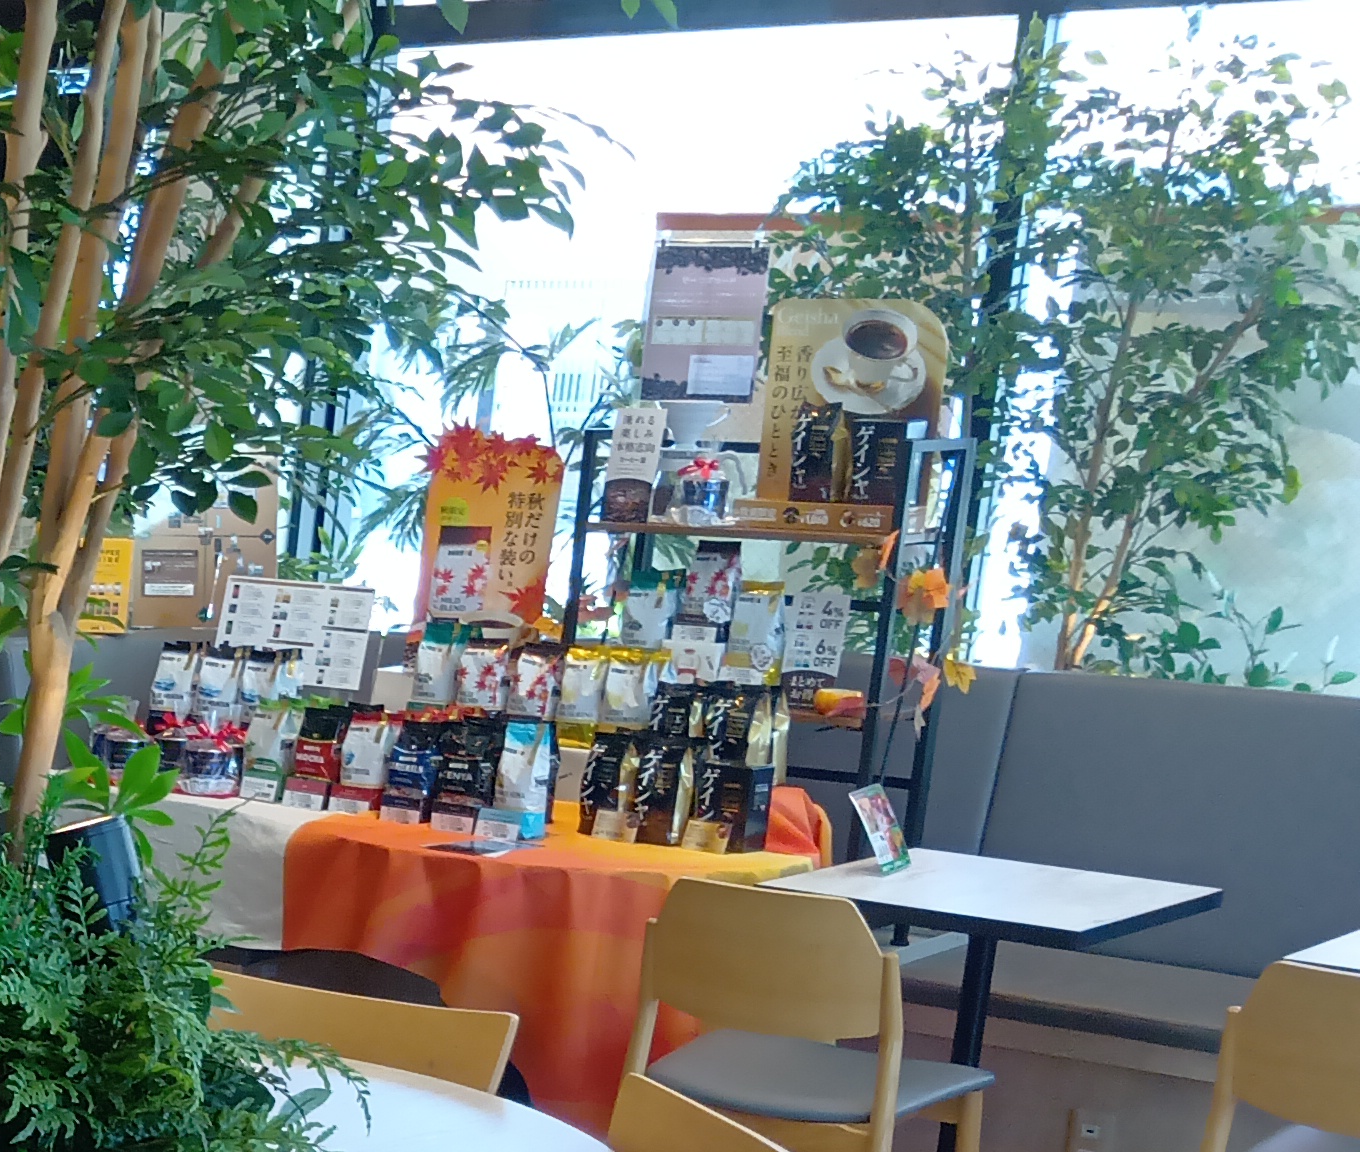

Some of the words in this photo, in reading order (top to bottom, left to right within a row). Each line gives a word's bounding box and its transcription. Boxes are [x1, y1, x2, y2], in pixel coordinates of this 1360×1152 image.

[777, 306, 840, 325] Geisha
[790, 344, 812, 421] 香り広が
[765, 344, 794, 478] 至福のひととき
[498, 491, 527, 588] 特別な装い。
[519, 491, 546, 565] 秋だけの
[814, 638, 838, 656] 6%
[819, 618, 843, 630] OFF
[813, 657, 836, 668] OFF
[698, 768, 721, 821] ゲイシ
